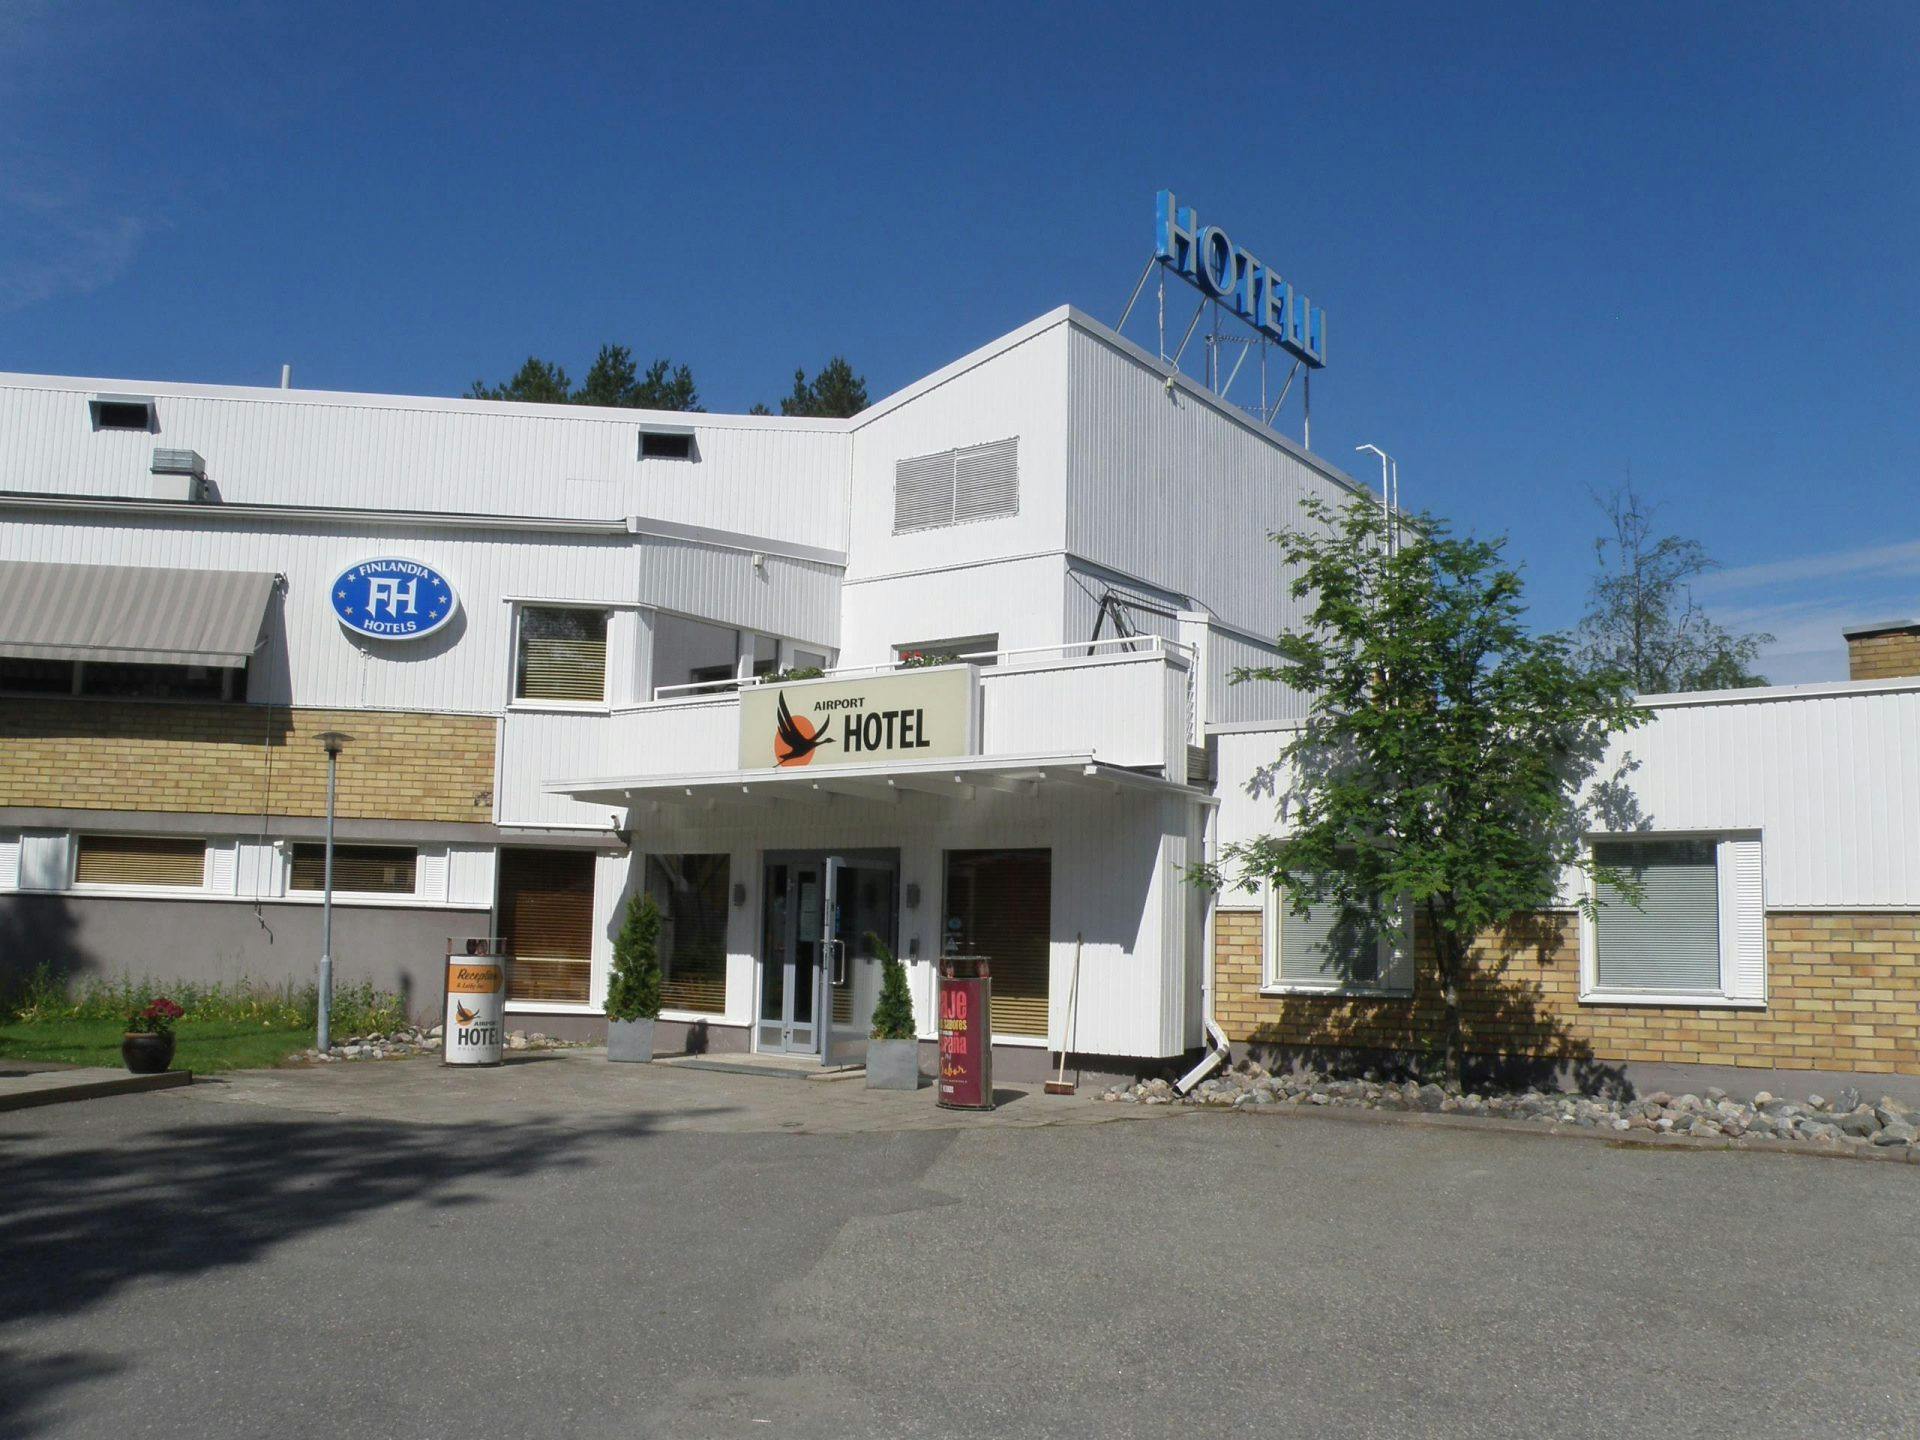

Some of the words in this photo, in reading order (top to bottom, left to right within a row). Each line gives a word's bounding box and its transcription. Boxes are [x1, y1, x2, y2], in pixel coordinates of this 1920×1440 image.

[1157, 188, 1327, 369] HOTELLI
[359, 561, 429, 579] FINLANDIA
[365, 577, 418, 619] FH
[363, 619, 417, 633] HOTELS
[814, 697, 865, 712] AIRPORT
[844, 709, 930, 752] HOTEL
